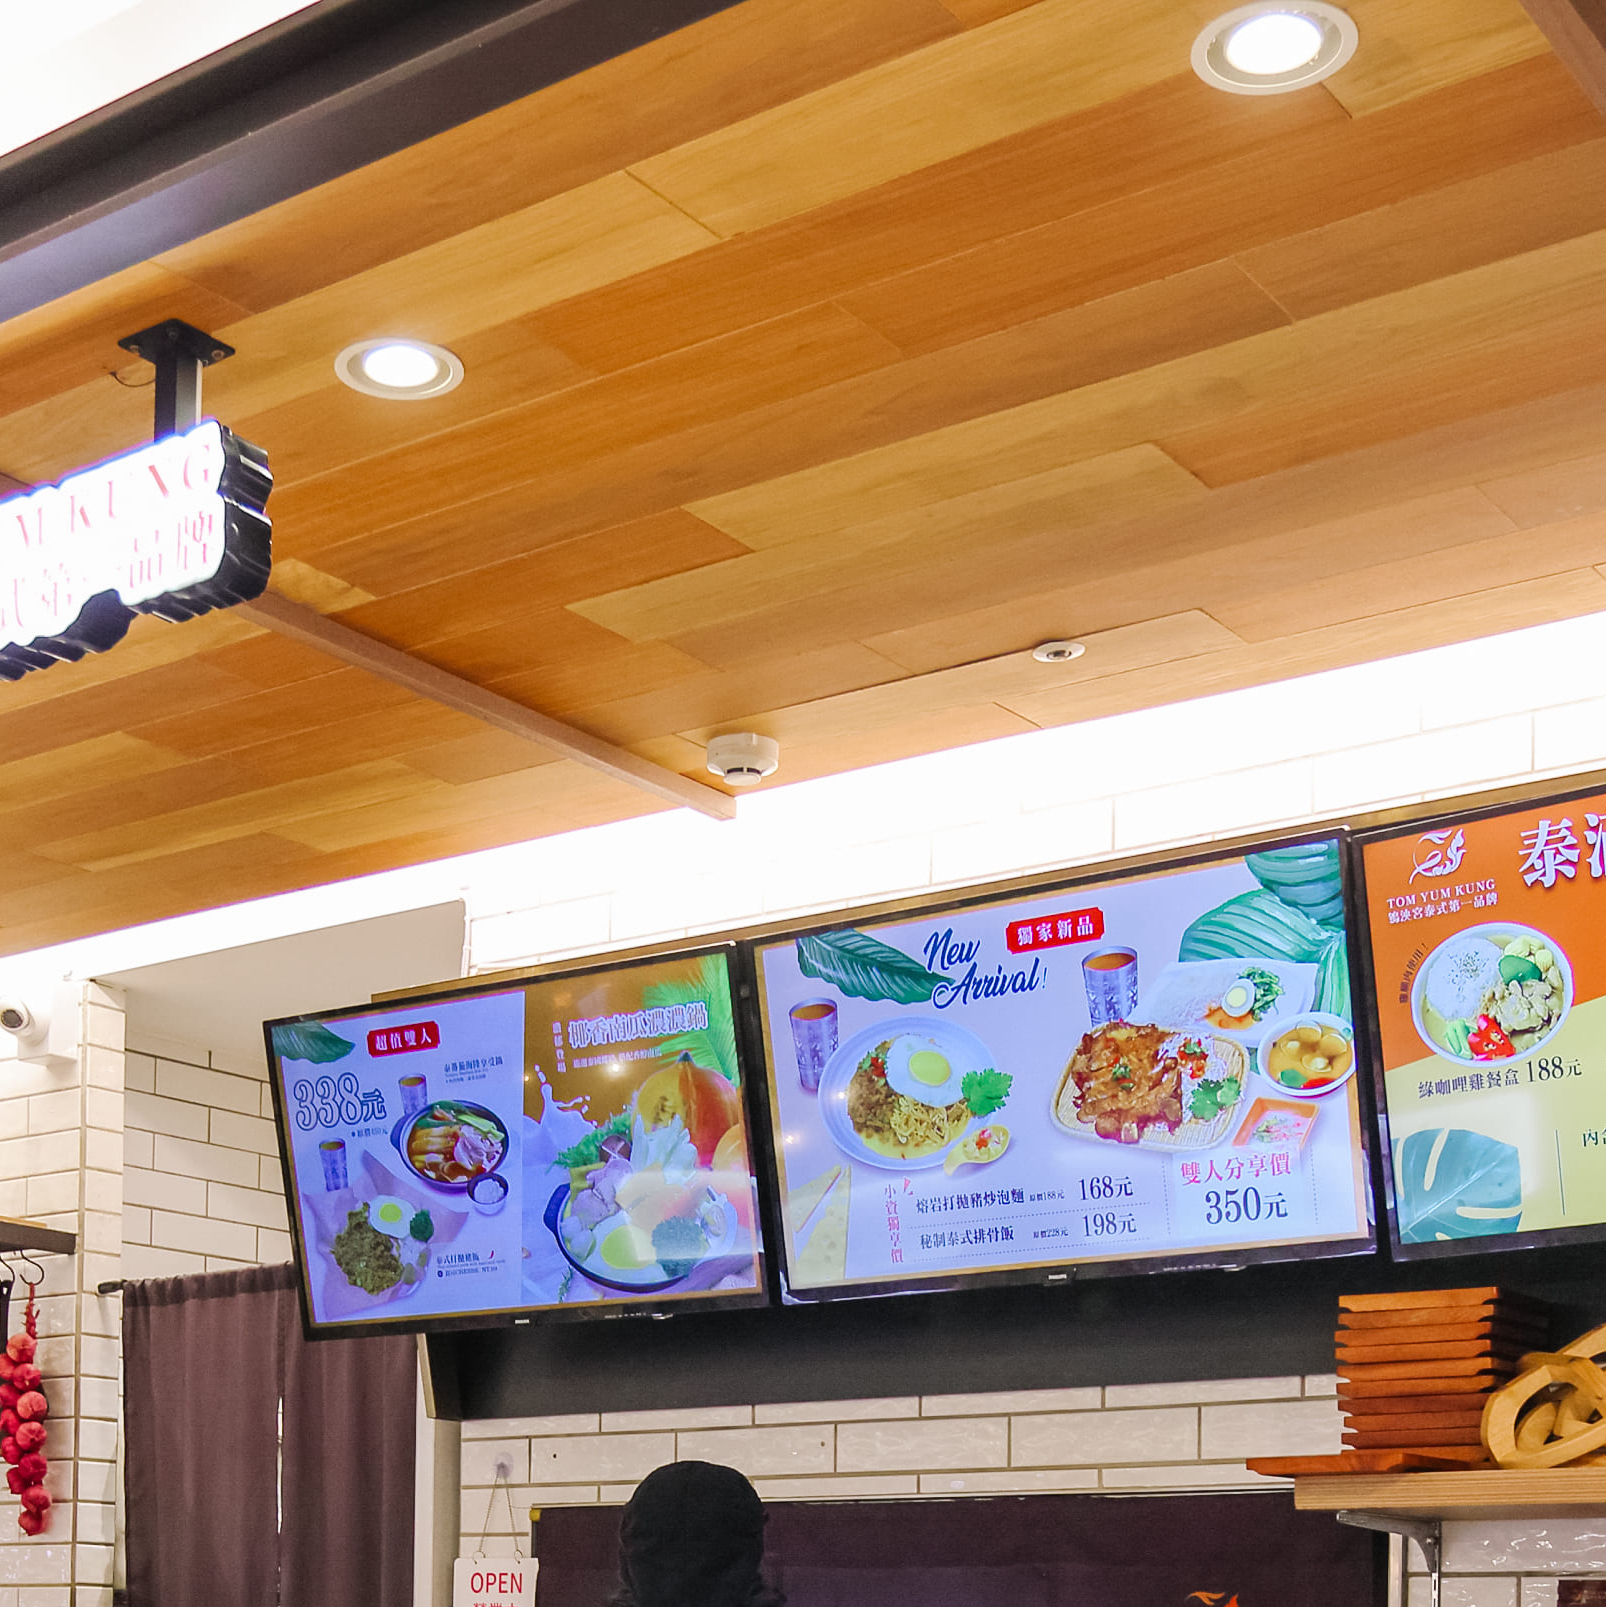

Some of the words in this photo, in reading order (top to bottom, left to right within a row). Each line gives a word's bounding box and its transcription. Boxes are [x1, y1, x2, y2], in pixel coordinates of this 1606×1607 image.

[1387, 893, 1417, 909] TOM
[1420, 887, 1451, 903] YUM
[1455, 878, 1496, 896] KUNG
[1017, 915, 1094, 946] 獨家新品
[923, 928, 981, 973] New
[375, 1027, 432, 1051] 超值雙人
[1418, 1067, 1519, 1099] 綠咖哩雞餐盒
[1525, 1056, 1583, 1084] 188元
[293, 1071, 388, 1132] 338元
[1181, 1152, 1292, 1186] 雙人分享價
[915, 1187, 1025, 1215] 熔岩打拋豬炒泡麵
[1078, 1175, 1134, 1202] 168元
[1205, 1186, 1289, 1225] 350元
[1083, 1212, 1137, 1238] 198元
[470, 1572, 523, 1594] OPEN
